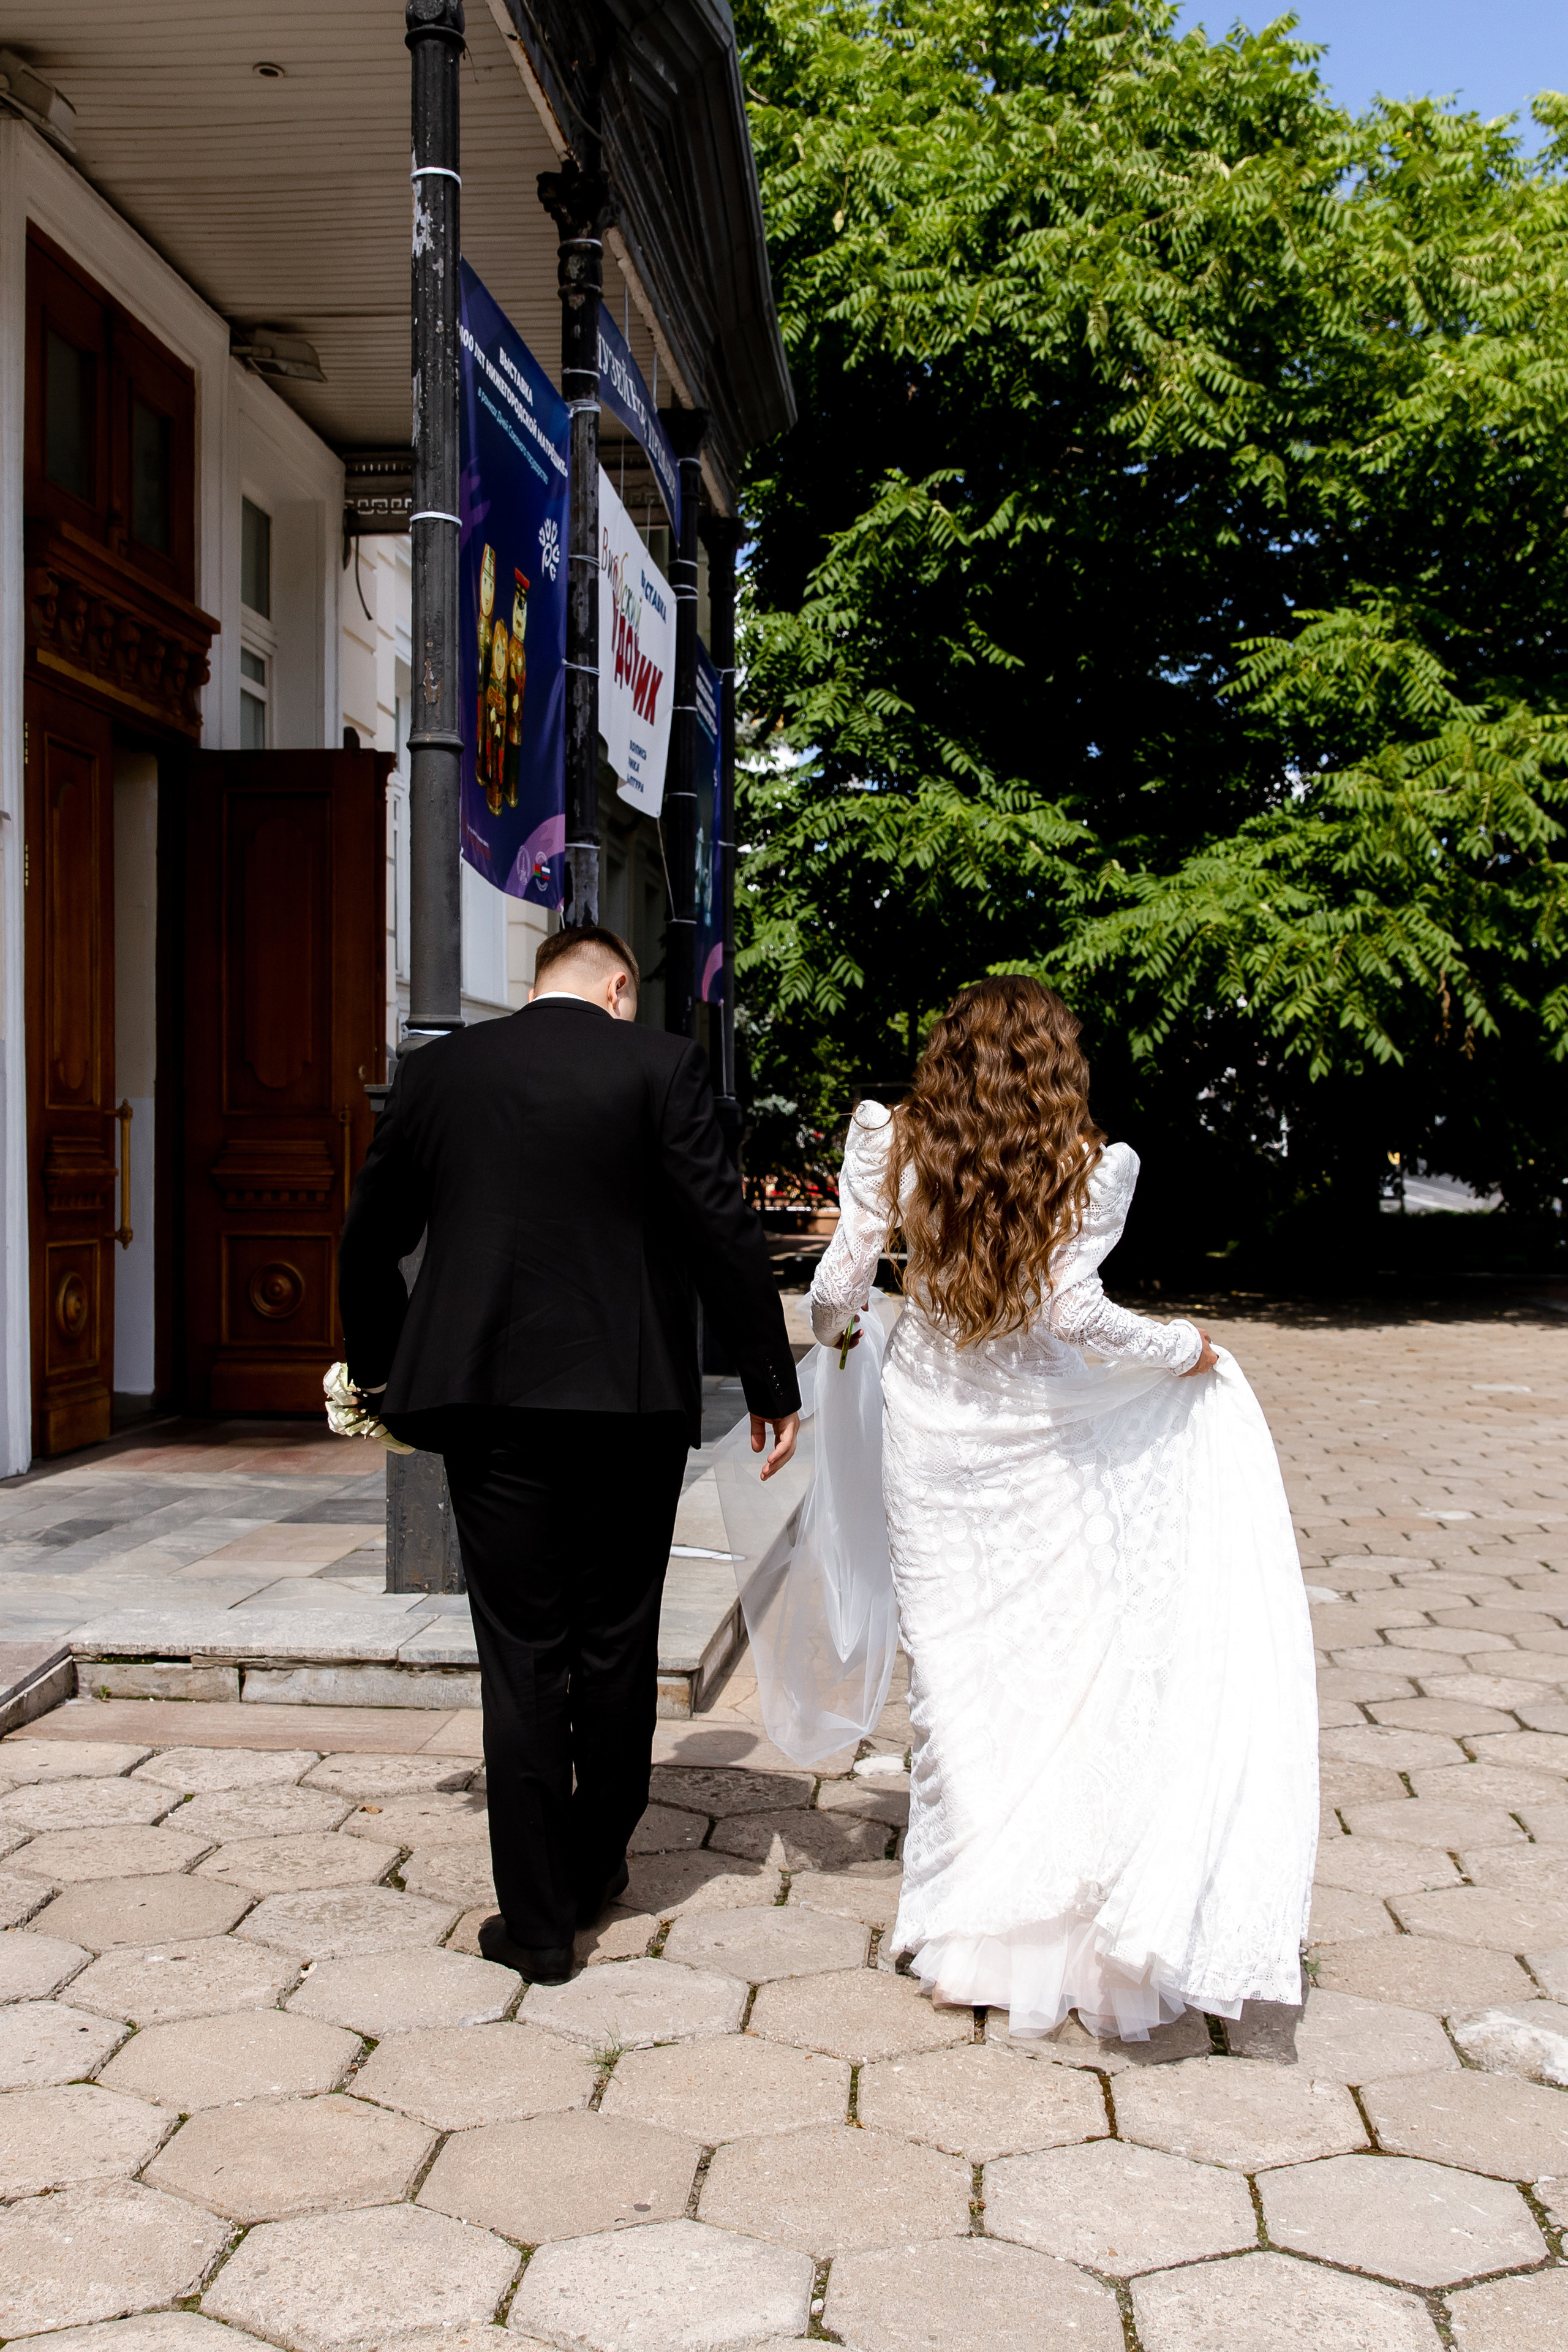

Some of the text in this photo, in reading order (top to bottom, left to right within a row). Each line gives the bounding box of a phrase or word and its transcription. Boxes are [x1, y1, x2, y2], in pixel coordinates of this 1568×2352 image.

[474, 341, 486, 369] ЛЕТ
[486, 358, 537, 439] НИЖЕГОРОДСКОЙ
[499, 346, 533, 407] ВЫСТАВКА
